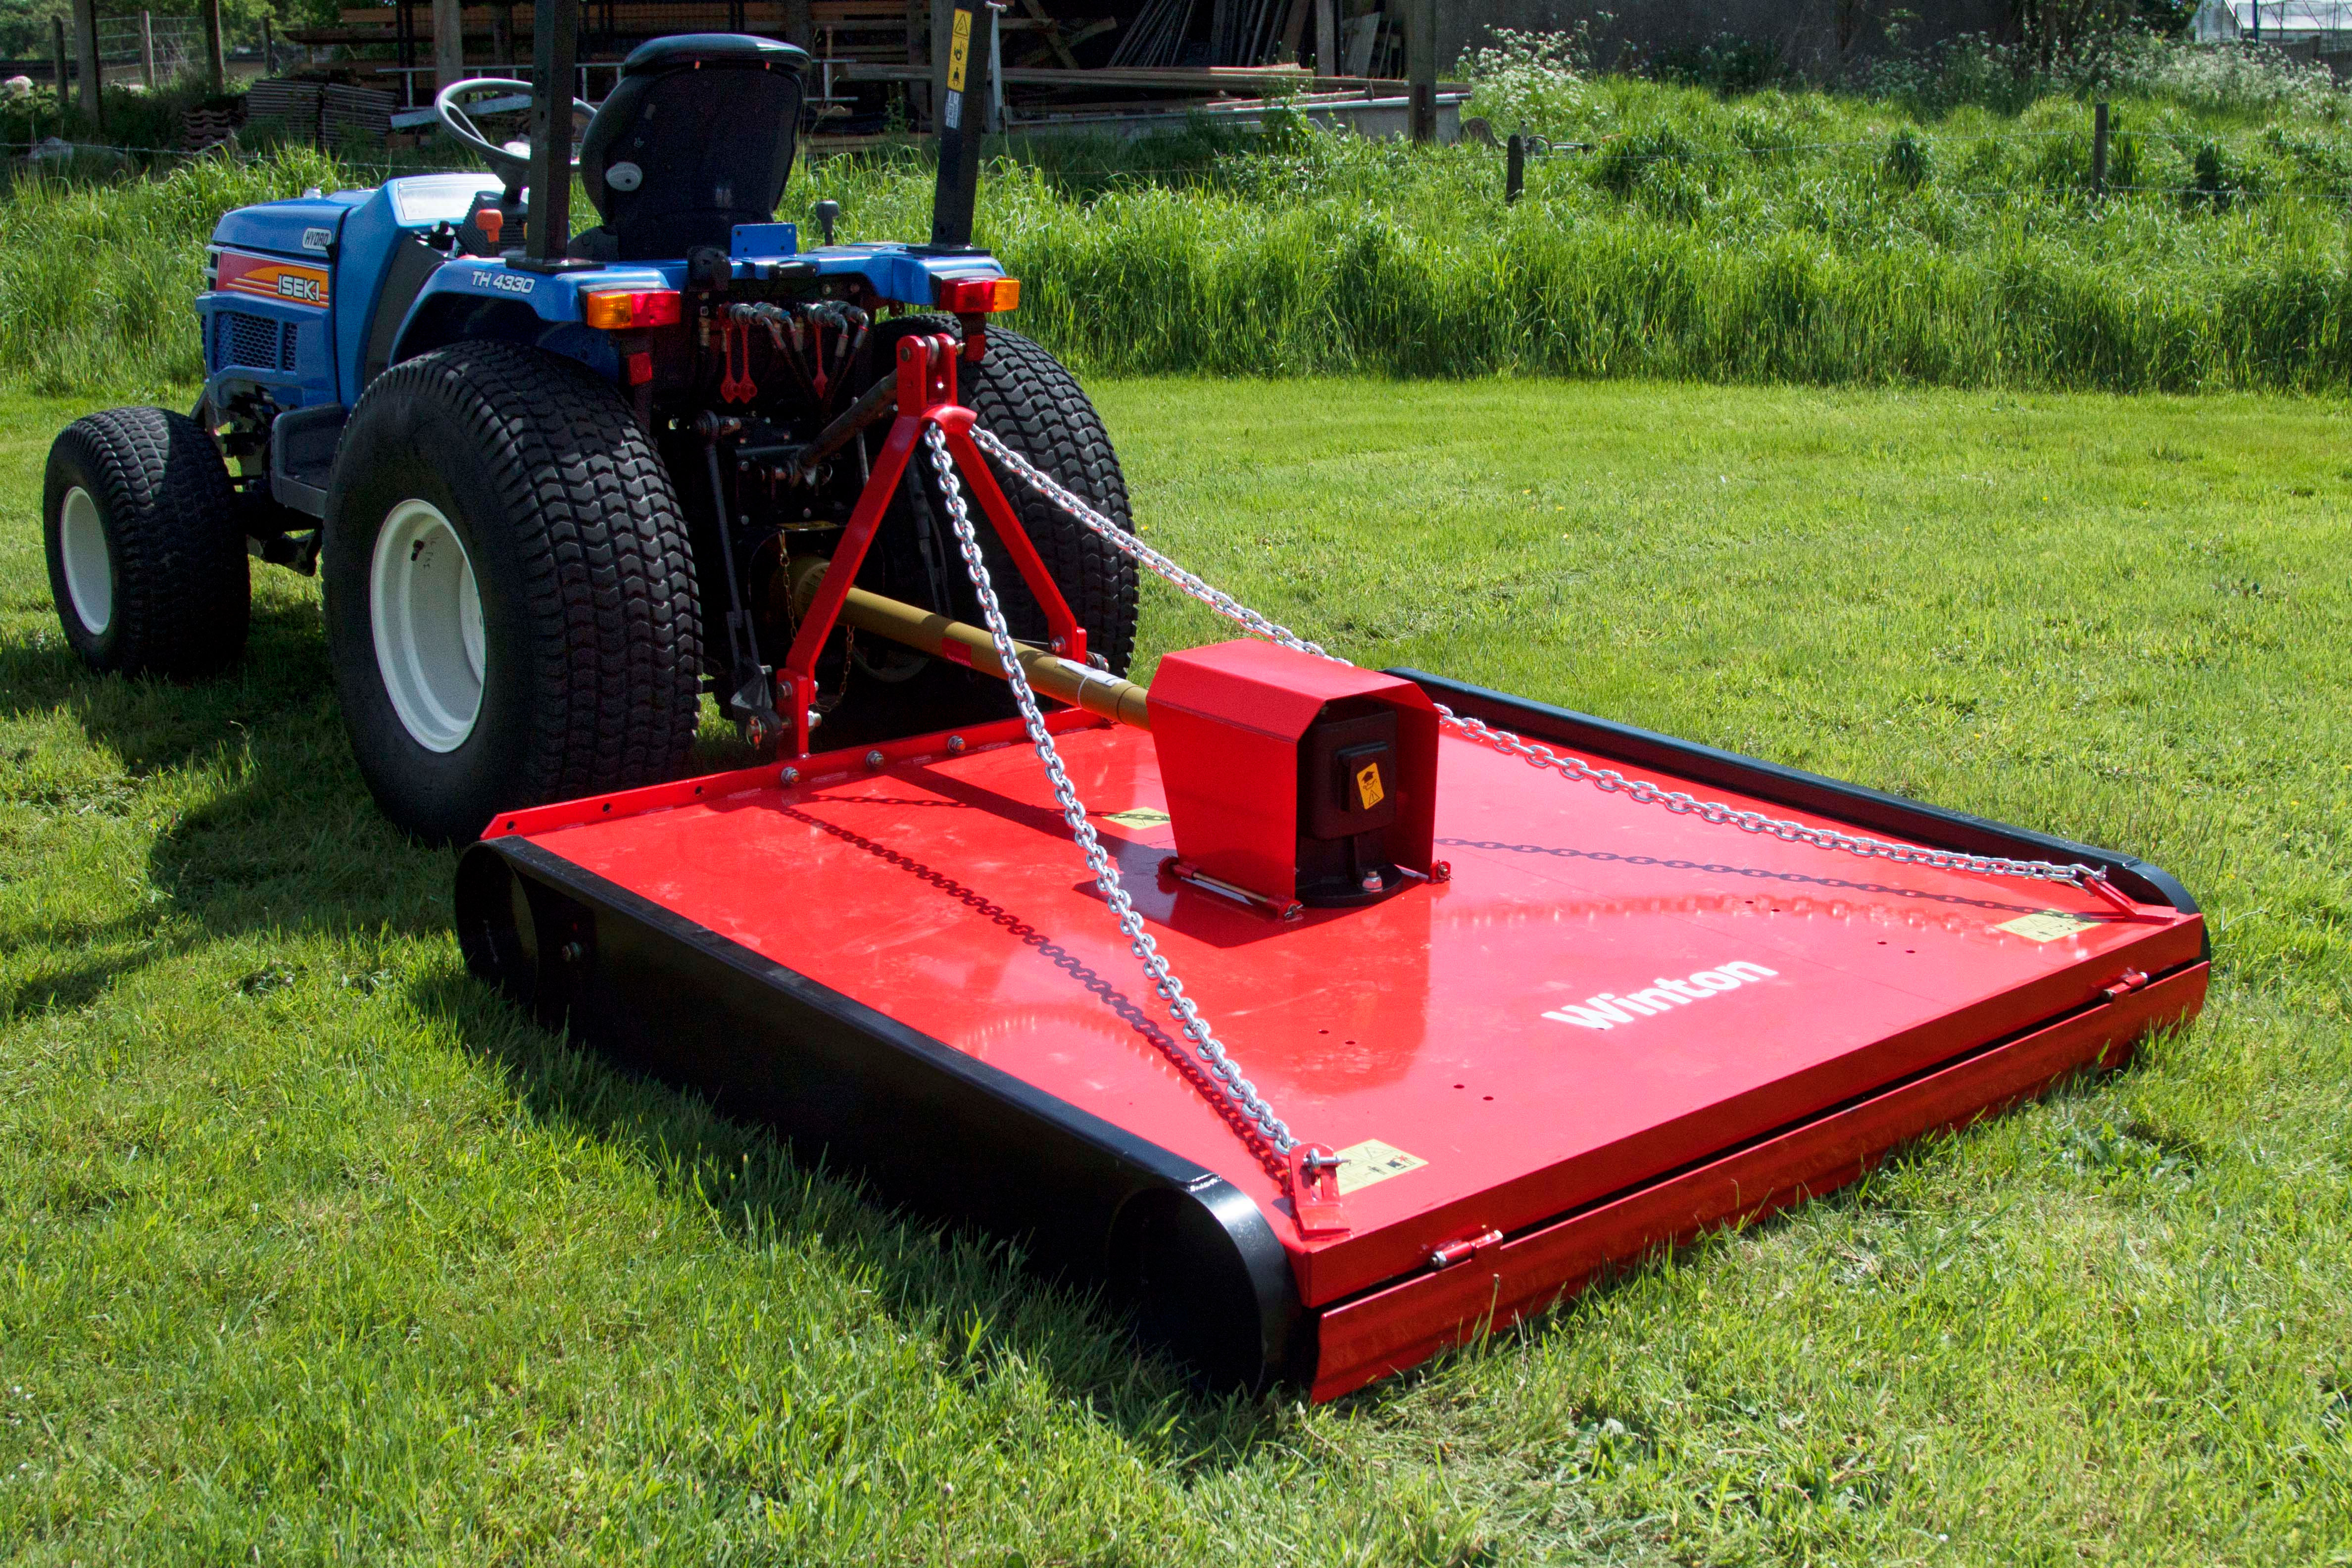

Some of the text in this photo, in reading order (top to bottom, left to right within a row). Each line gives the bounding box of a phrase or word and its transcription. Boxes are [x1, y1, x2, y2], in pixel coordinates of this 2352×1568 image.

[305, 231, 329, 246] HYDRO
[278, 275, 320, 300] ISEKI
[473, 271, 536, 294] TH 4330
[1541, 961, 1779, 1030] Winton
